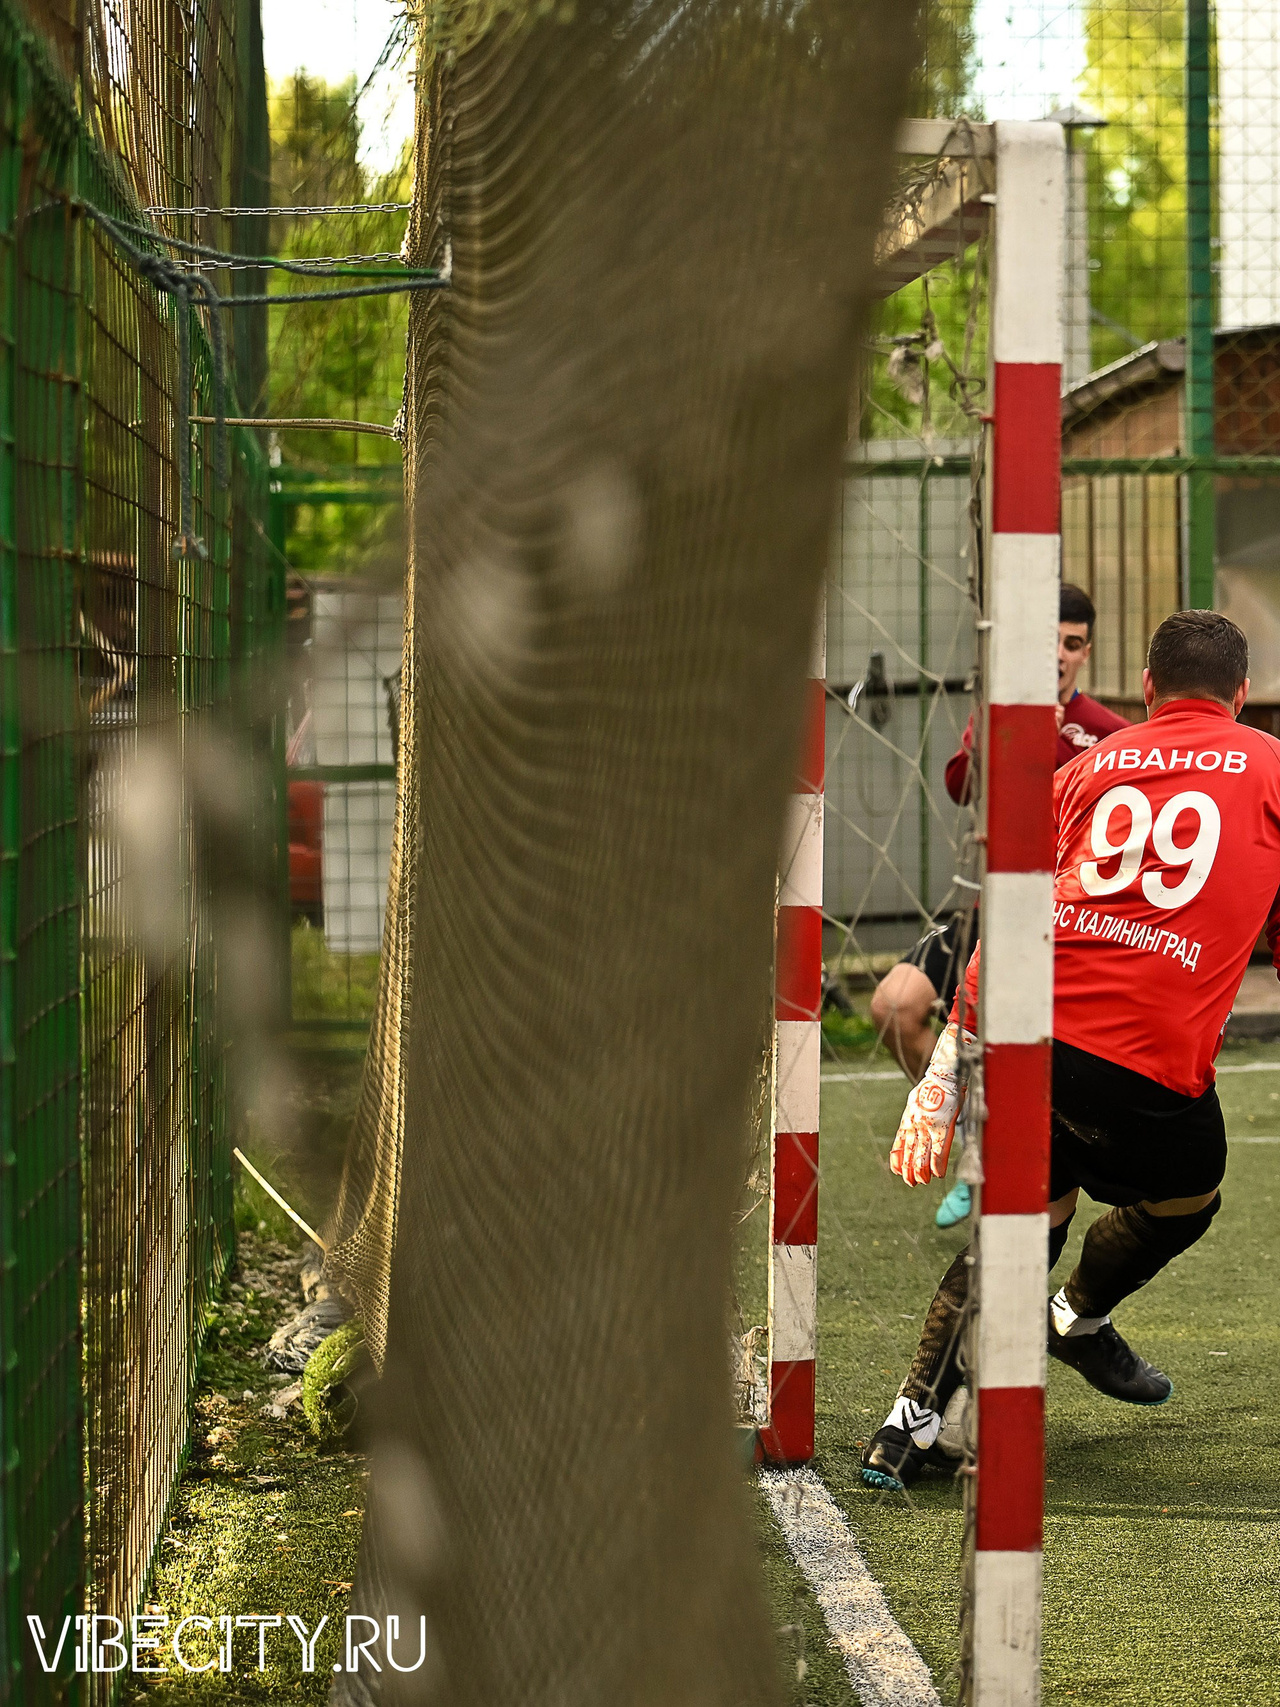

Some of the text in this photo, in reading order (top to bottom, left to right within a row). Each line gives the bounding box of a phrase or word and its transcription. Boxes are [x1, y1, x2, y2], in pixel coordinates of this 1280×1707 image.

[1092, 747, 1248, 774] ИВАНОВ
[1080, 785, 1221, 909] 99
[1074, 908, 1203, 972] КАЛИНИНГРАД
